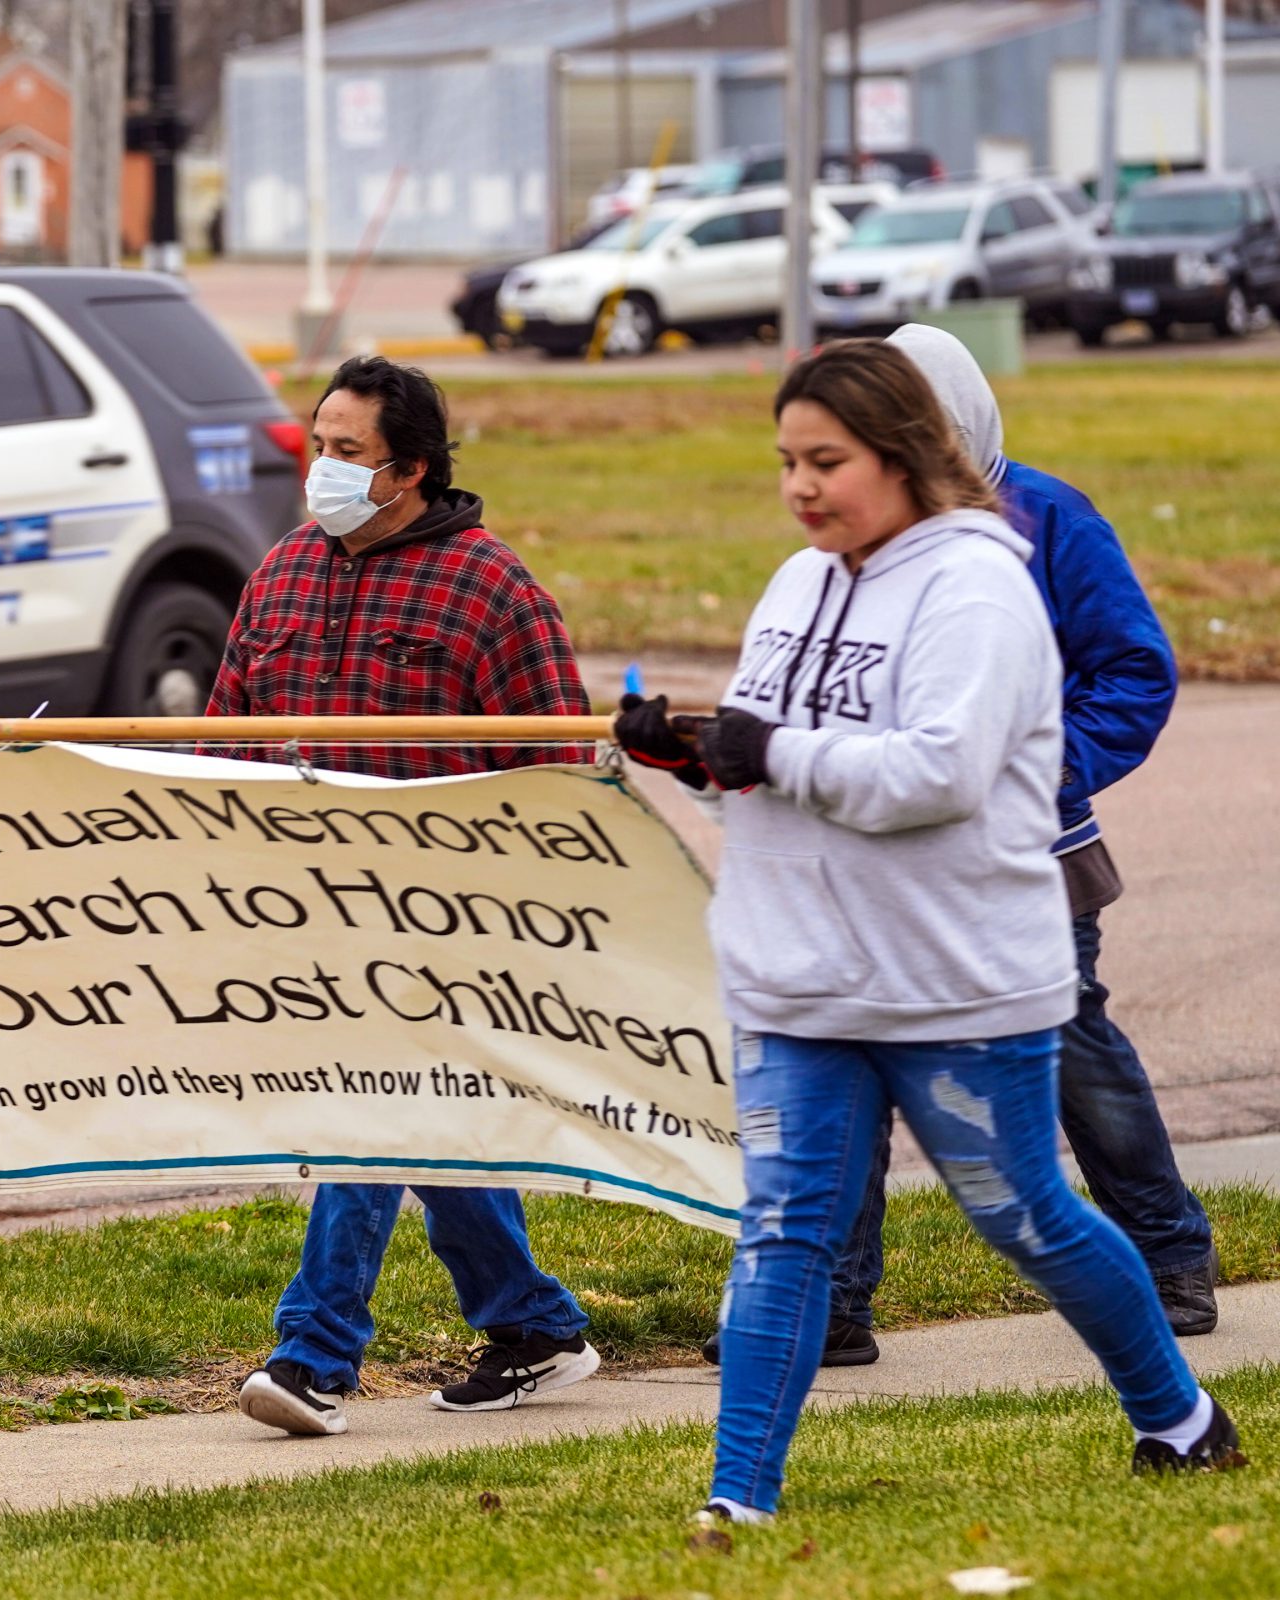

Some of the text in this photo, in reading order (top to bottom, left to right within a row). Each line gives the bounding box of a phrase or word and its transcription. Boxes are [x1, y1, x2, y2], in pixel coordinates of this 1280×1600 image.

[163, 786, 631, 870] Memorial
[205, 873, 310, 930] to
[304, 866, 612, 954] Honor
[134, 960, 367, 1026] Lost
[364, 959, 728, 1087] Children
[23, 1075, 108, 1113] grow
[115, 1065, 169, 1097] old
[171, 1066, 245, 1103] they
[250, 1066, 334, 1094] must
[334, 1061, 422, 1097] know
[428, 1062, 497, 1099] that
[647, 1100, 694, 1139] for
